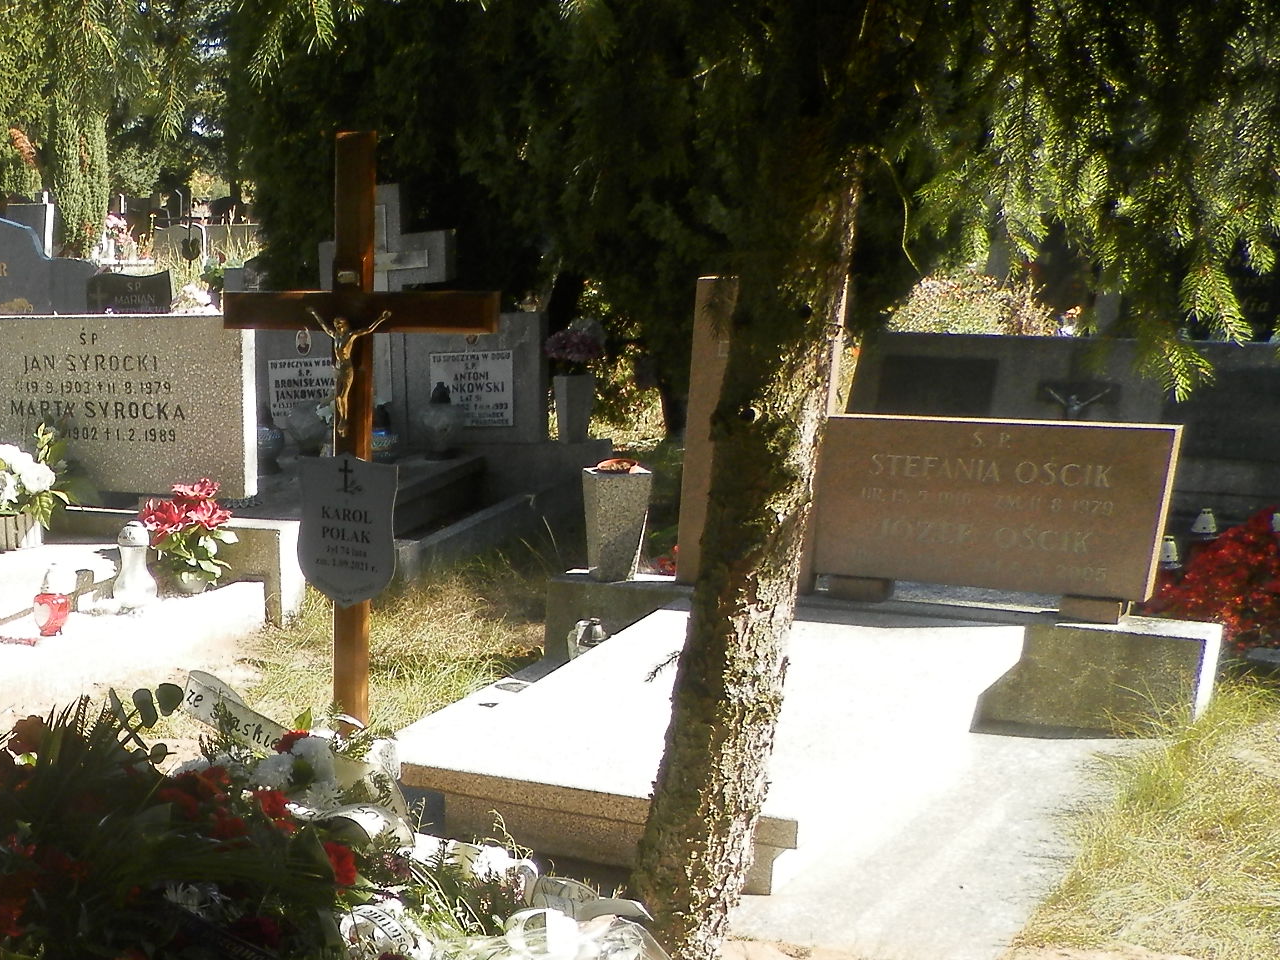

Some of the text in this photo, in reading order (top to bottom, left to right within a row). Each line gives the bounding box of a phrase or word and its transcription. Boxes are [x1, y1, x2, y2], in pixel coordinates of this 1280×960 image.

[24, 353, 158, 375] JAN SYROCKI
[453, 371, 489, 382] ANTONI
[84, 402, 186, 421] SYROCKA
[869, 453, 1113, 489] STEFANIA OŚCIK
[321, 505, 373, 524] KAROL
[321, 525, 371, 544] POLAK
[993, 524, 1094, 553] OŚCIK
